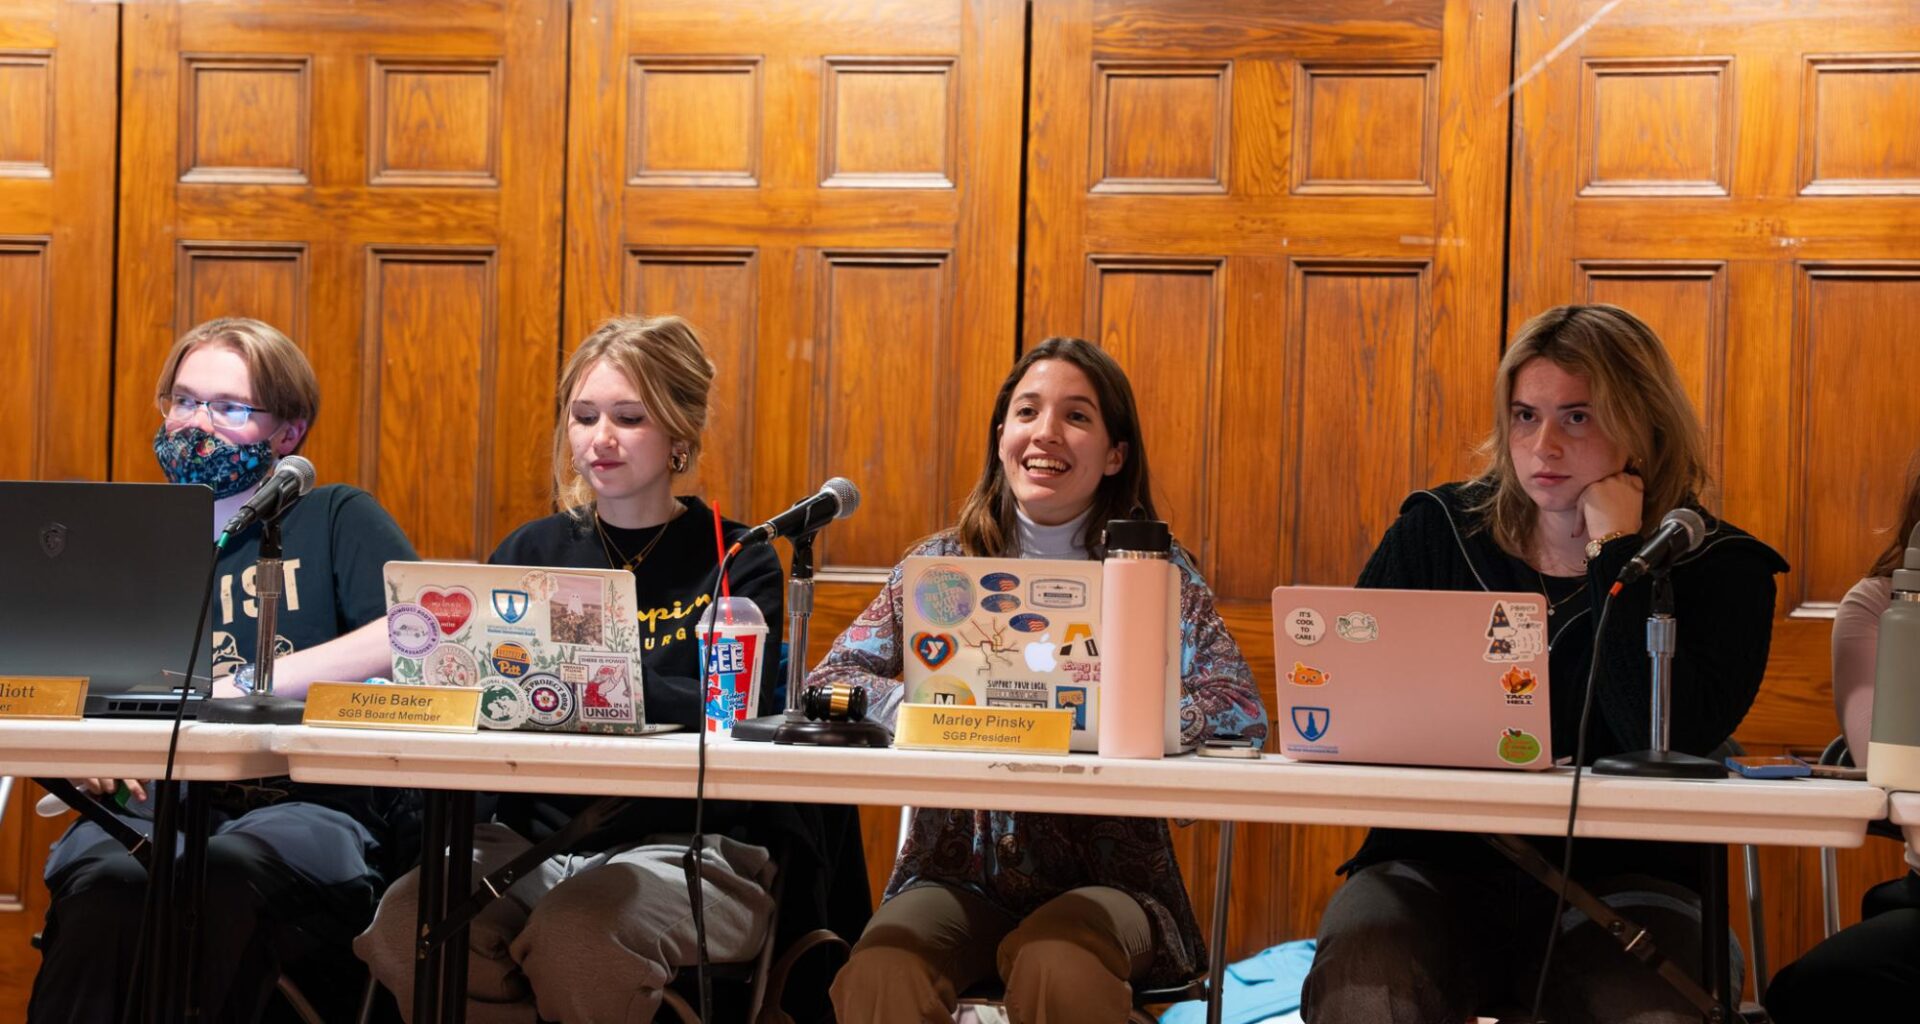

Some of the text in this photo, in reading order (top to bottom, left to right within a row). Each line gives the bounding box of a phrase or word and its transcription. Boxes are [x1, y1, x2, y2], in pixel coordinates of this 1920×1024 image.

[644, 627, 699, 650] URG
[497, 661, 521, 675] Pitt
[987, 680, 1048, 690] SUPPORT YOUR LOCAL
[351, 693, 432, 707] Kylie Baker
[338, 709, 441, 722] SGB Board Member
[586, 708, 629, 718] UNION
[933, 713, 1035, 731] Marley Pinsky
[943, 731, 1021, 743] SGB President
